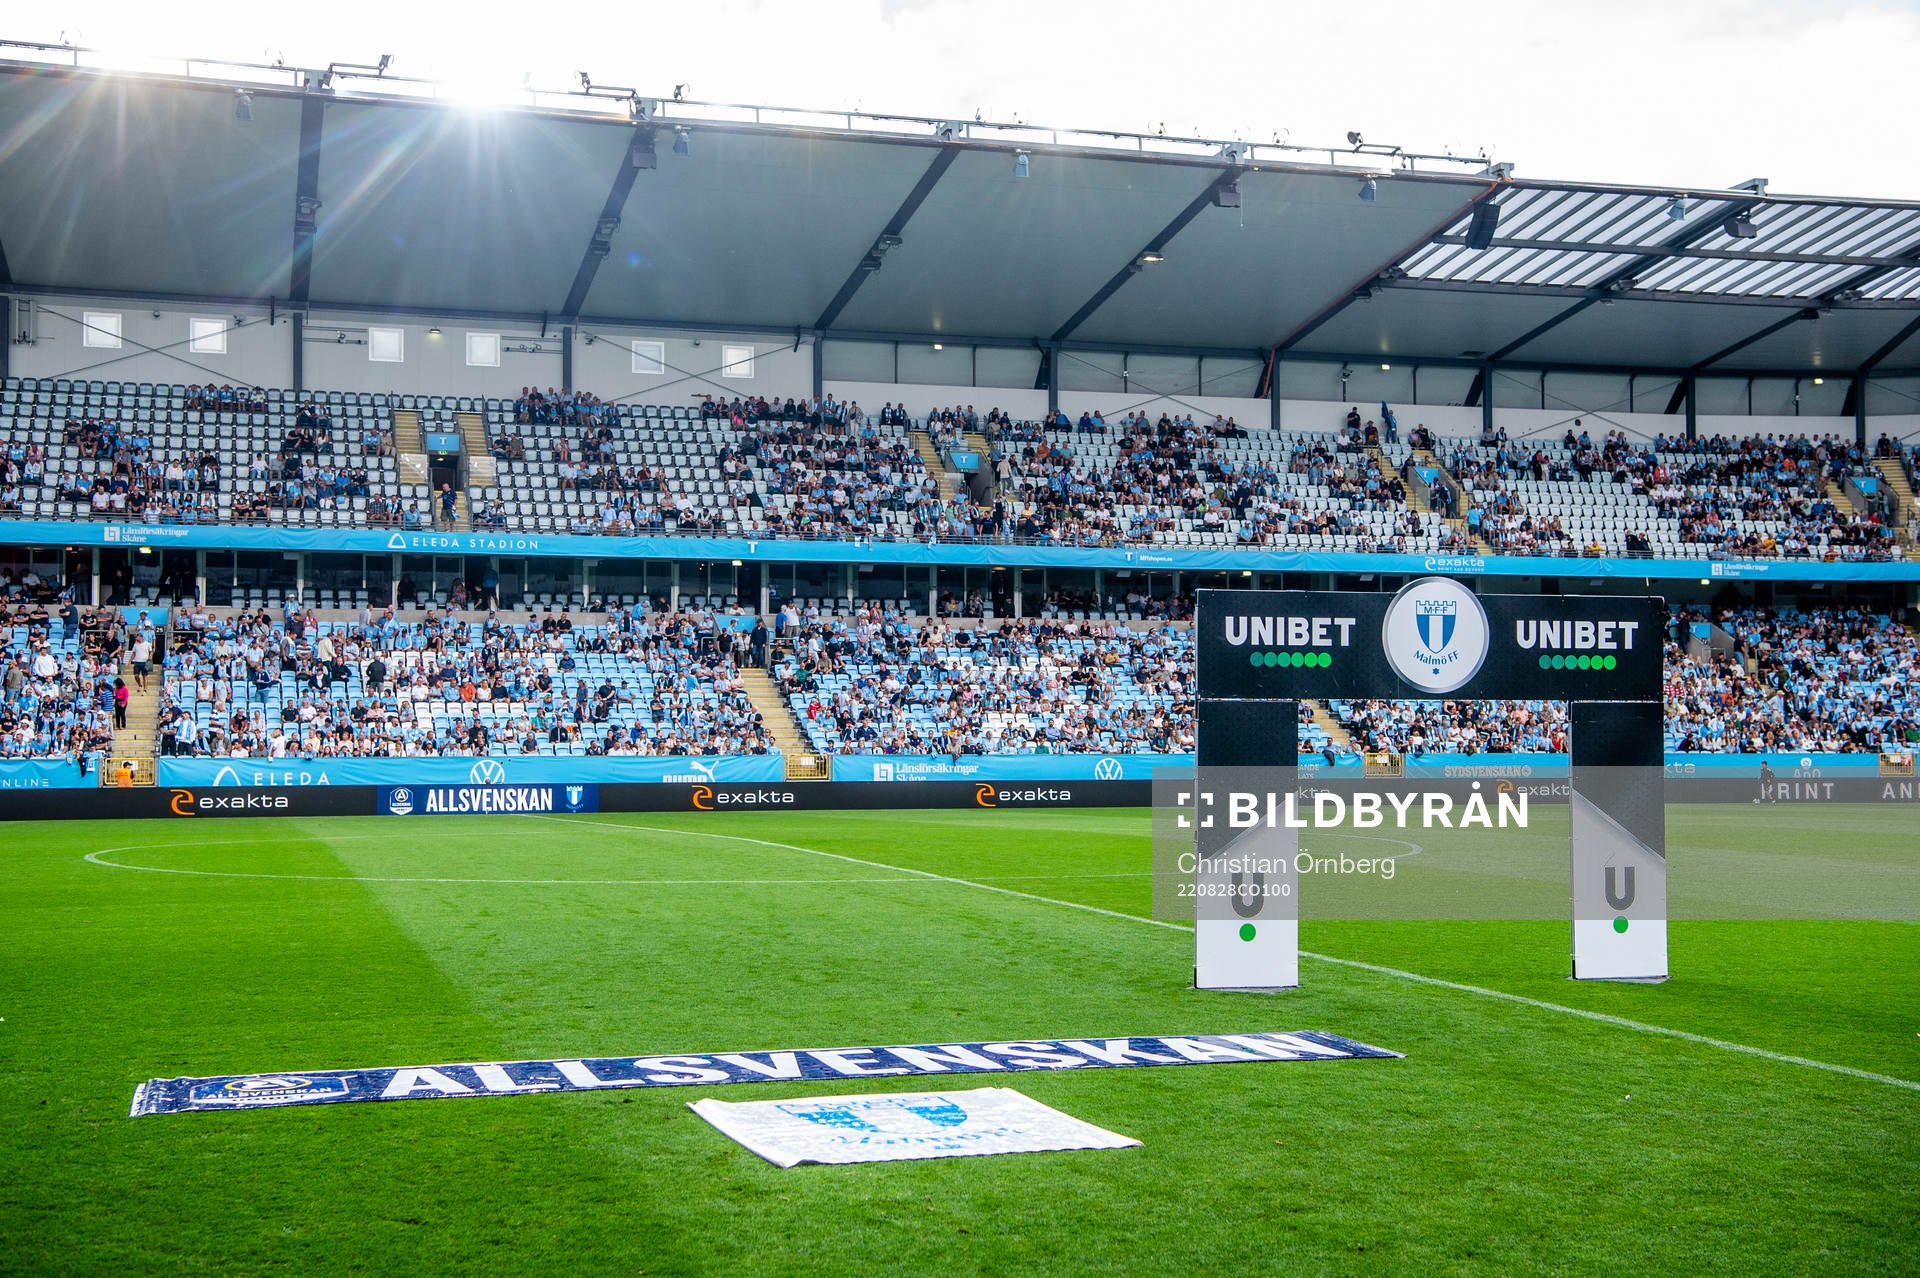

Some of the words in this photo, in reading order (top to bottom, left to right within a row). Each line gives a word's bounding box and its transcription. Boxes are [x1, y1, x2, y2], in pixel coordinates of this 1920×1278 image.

[413, 538, 460, 548] ELEDA
[469, 539, 539, 550] STADION
[1437, 557, 1484, 567] exakta
[1225, 616, 1356, 647] UNIBET
[1517, 620, 1639, 650] UNIBET
[1413, 650, 1447, 665] Malmö
[1447, 650, 1459, 663] FF
[896, 763, 979, 776] Länsförsäkringar
[1444, 766, 1521, 777] SYDSVENSKAN
[253, 772, 331, 786] ELEDA
[717, 789, 795, 804] exakta
[998, 787, 1071, 801] exakta
[1517, 783, 1571, 796] exakt
[1882, 783, 1920, 799] AN
[199, 793, 290, 809] exakta
[426, 788, 553, 812] ALLSVENSKAN
[1605, 867, 1636, 911] U
[380, 1032, 1355, 1101] ALLSVENSKAN
